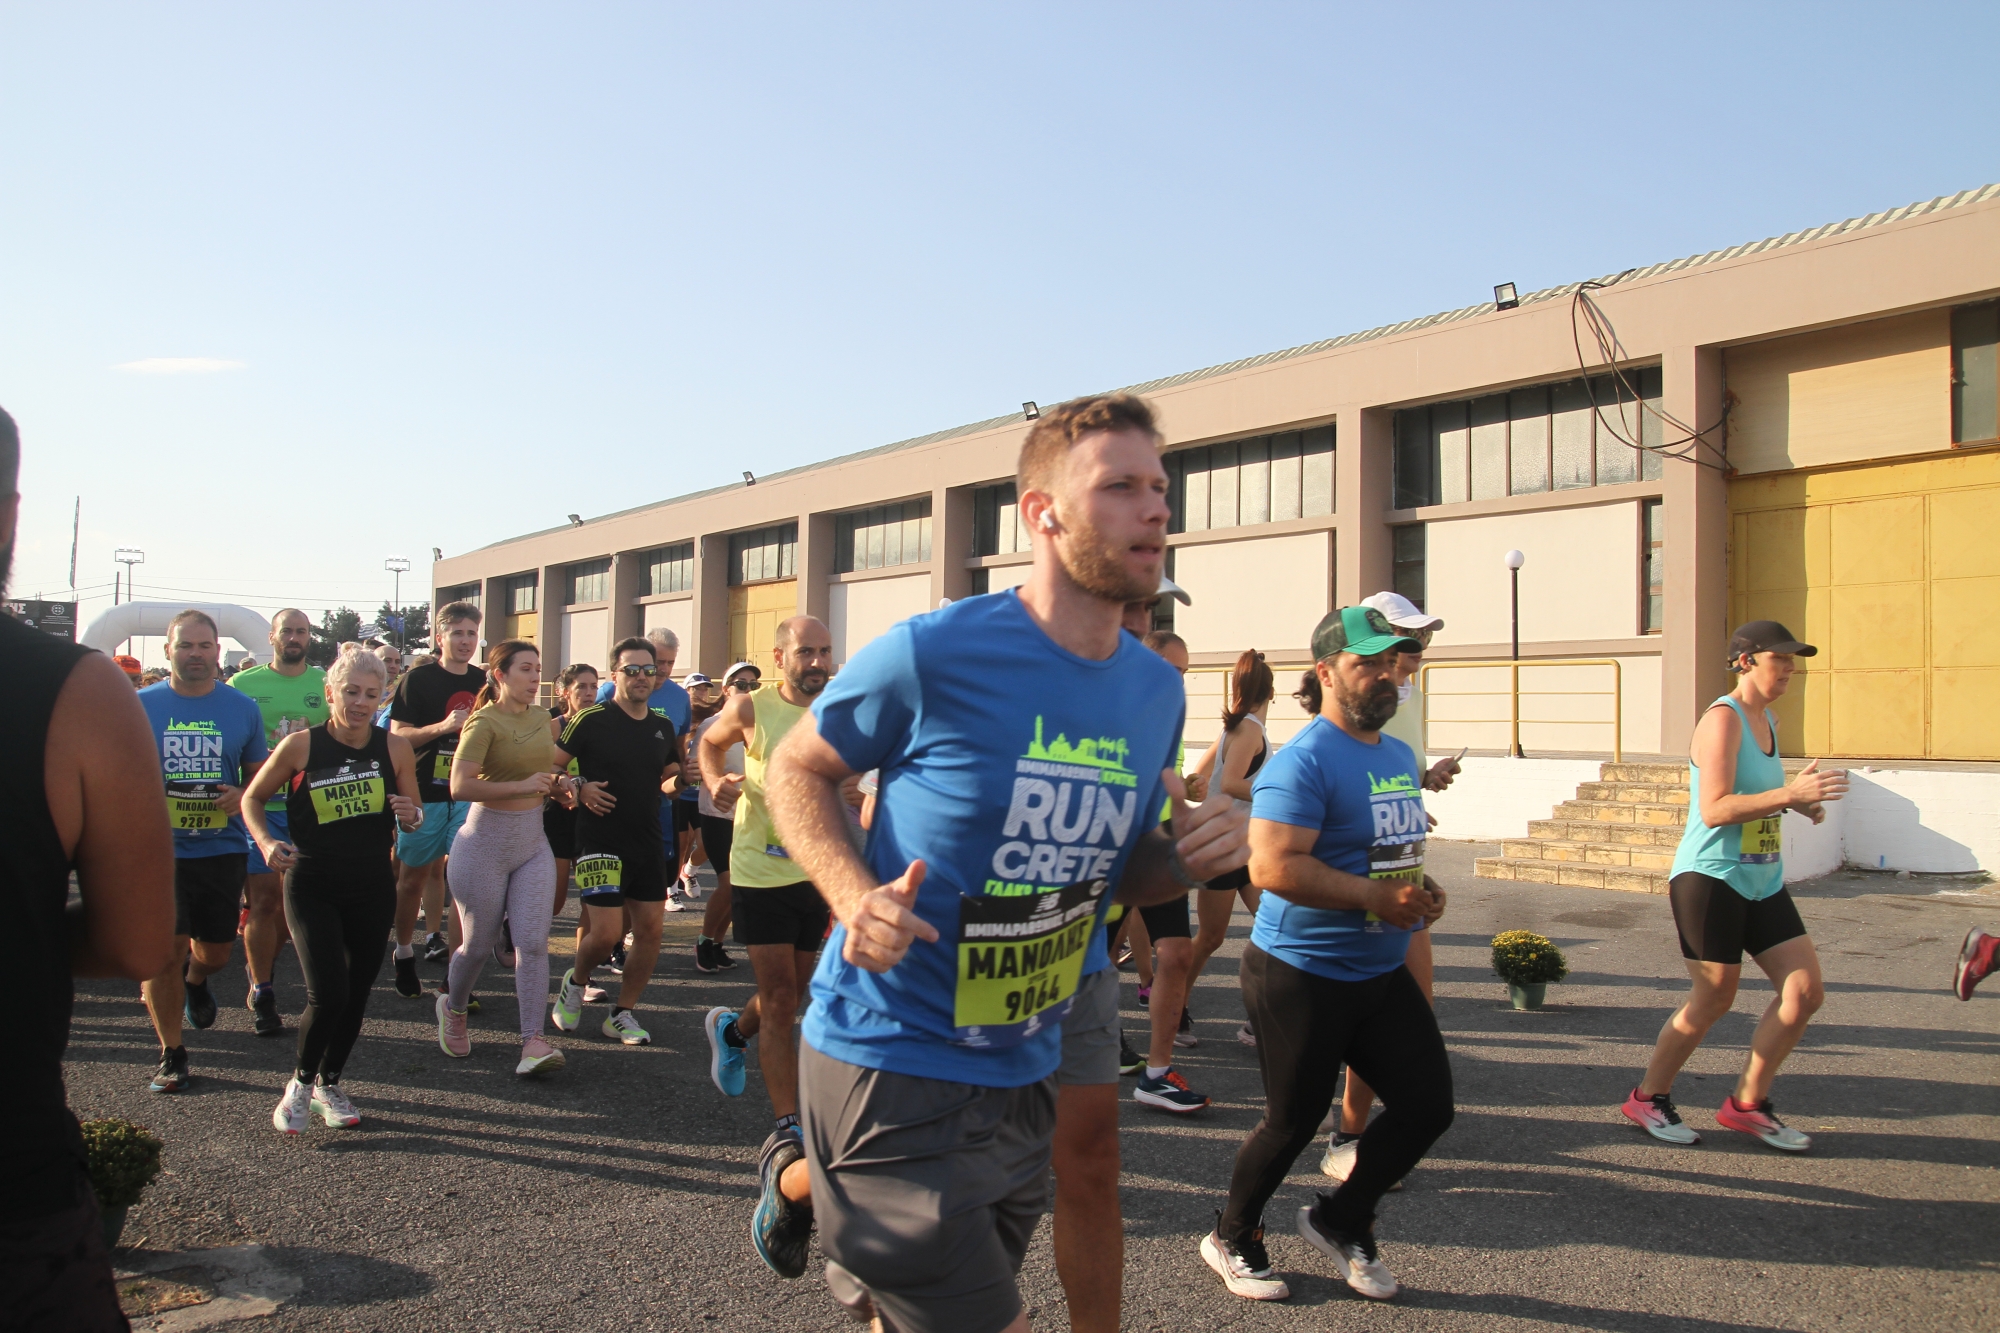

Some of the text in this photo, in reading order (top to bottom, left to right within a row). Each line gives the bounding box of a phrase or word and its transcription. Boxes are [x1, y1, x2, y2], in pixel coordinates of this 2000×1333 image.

[164, 736, 222, 757] RUN
[164, 757, 221, 772] CRETE
[324, 781, 373, 802] ΜΑΡΙΑ
[335, 799, 370, 818] 9145
[1002, 776, 1137, 847] RUN
[1371, 798, 1427, 838] RUN
[180, 816, 211, 828] 9289
[992, 840, 1119, 883] CRETE
[583, 874, 608, 887] 8122
[1006, 974, 1060, 1022] 9064
